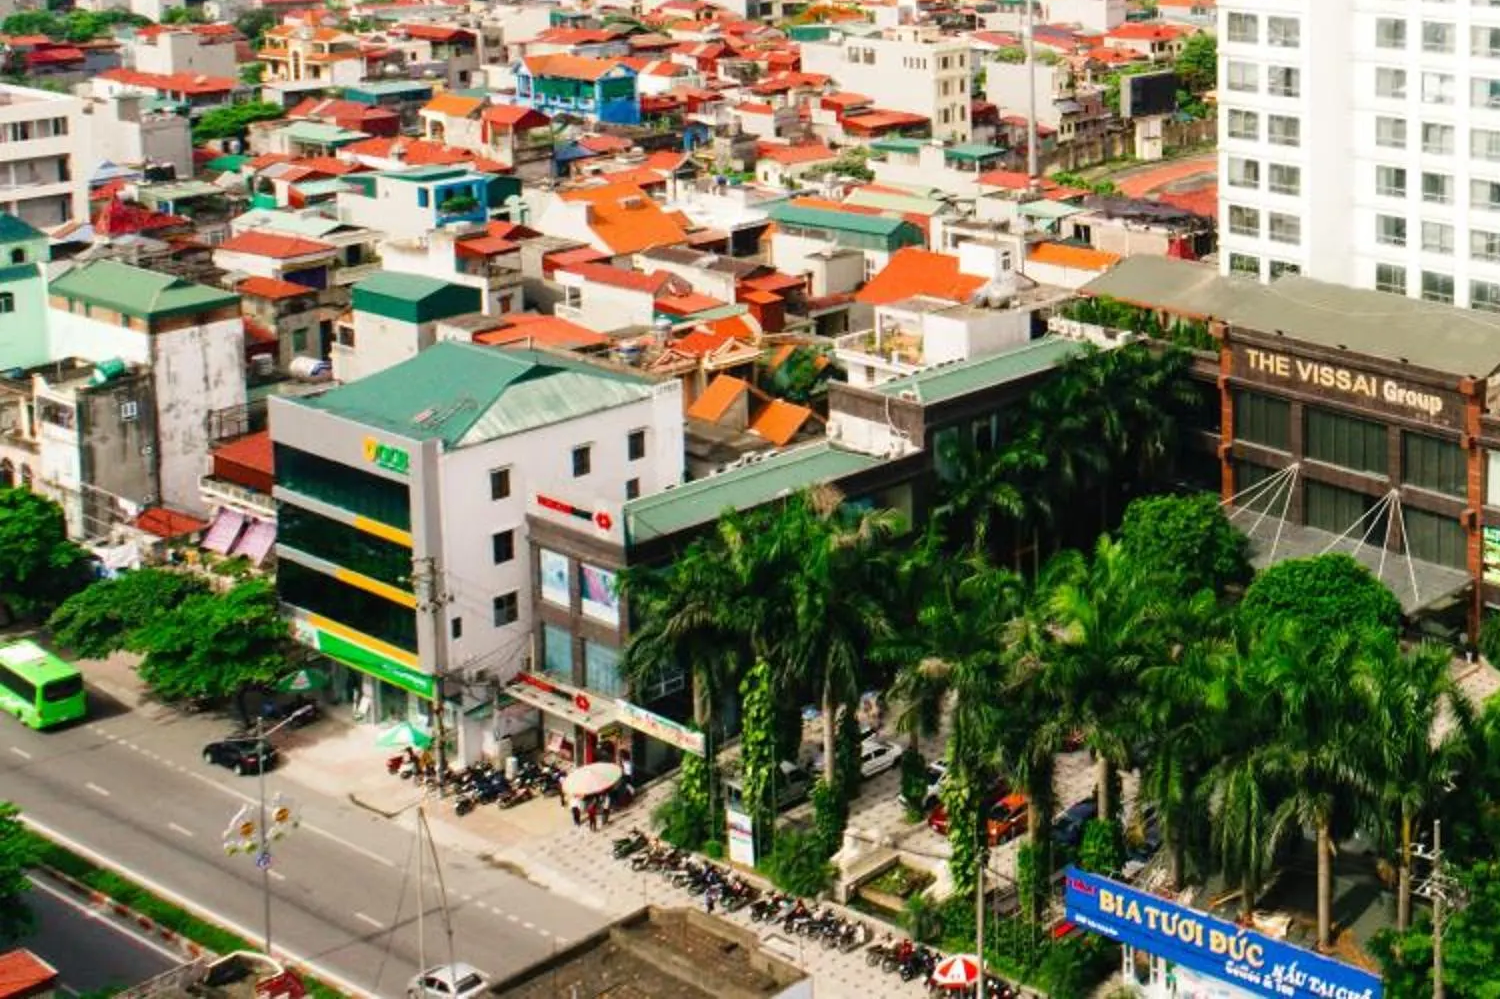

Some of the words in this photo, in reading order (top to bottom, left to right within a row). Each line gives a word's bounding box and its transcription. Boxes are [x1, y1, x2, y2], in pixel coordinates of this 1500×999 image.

[1245, 349, 1290, 377] THE
[1296, 359, 1377, 398] VISSAI
[1382, 379, 1444, 417] Group
[1099, 888, 1143, 925] BIA
[1143, 905, 1204, 948] TƯƠI
[1208, 926, 1266, 969] ĐỨC
